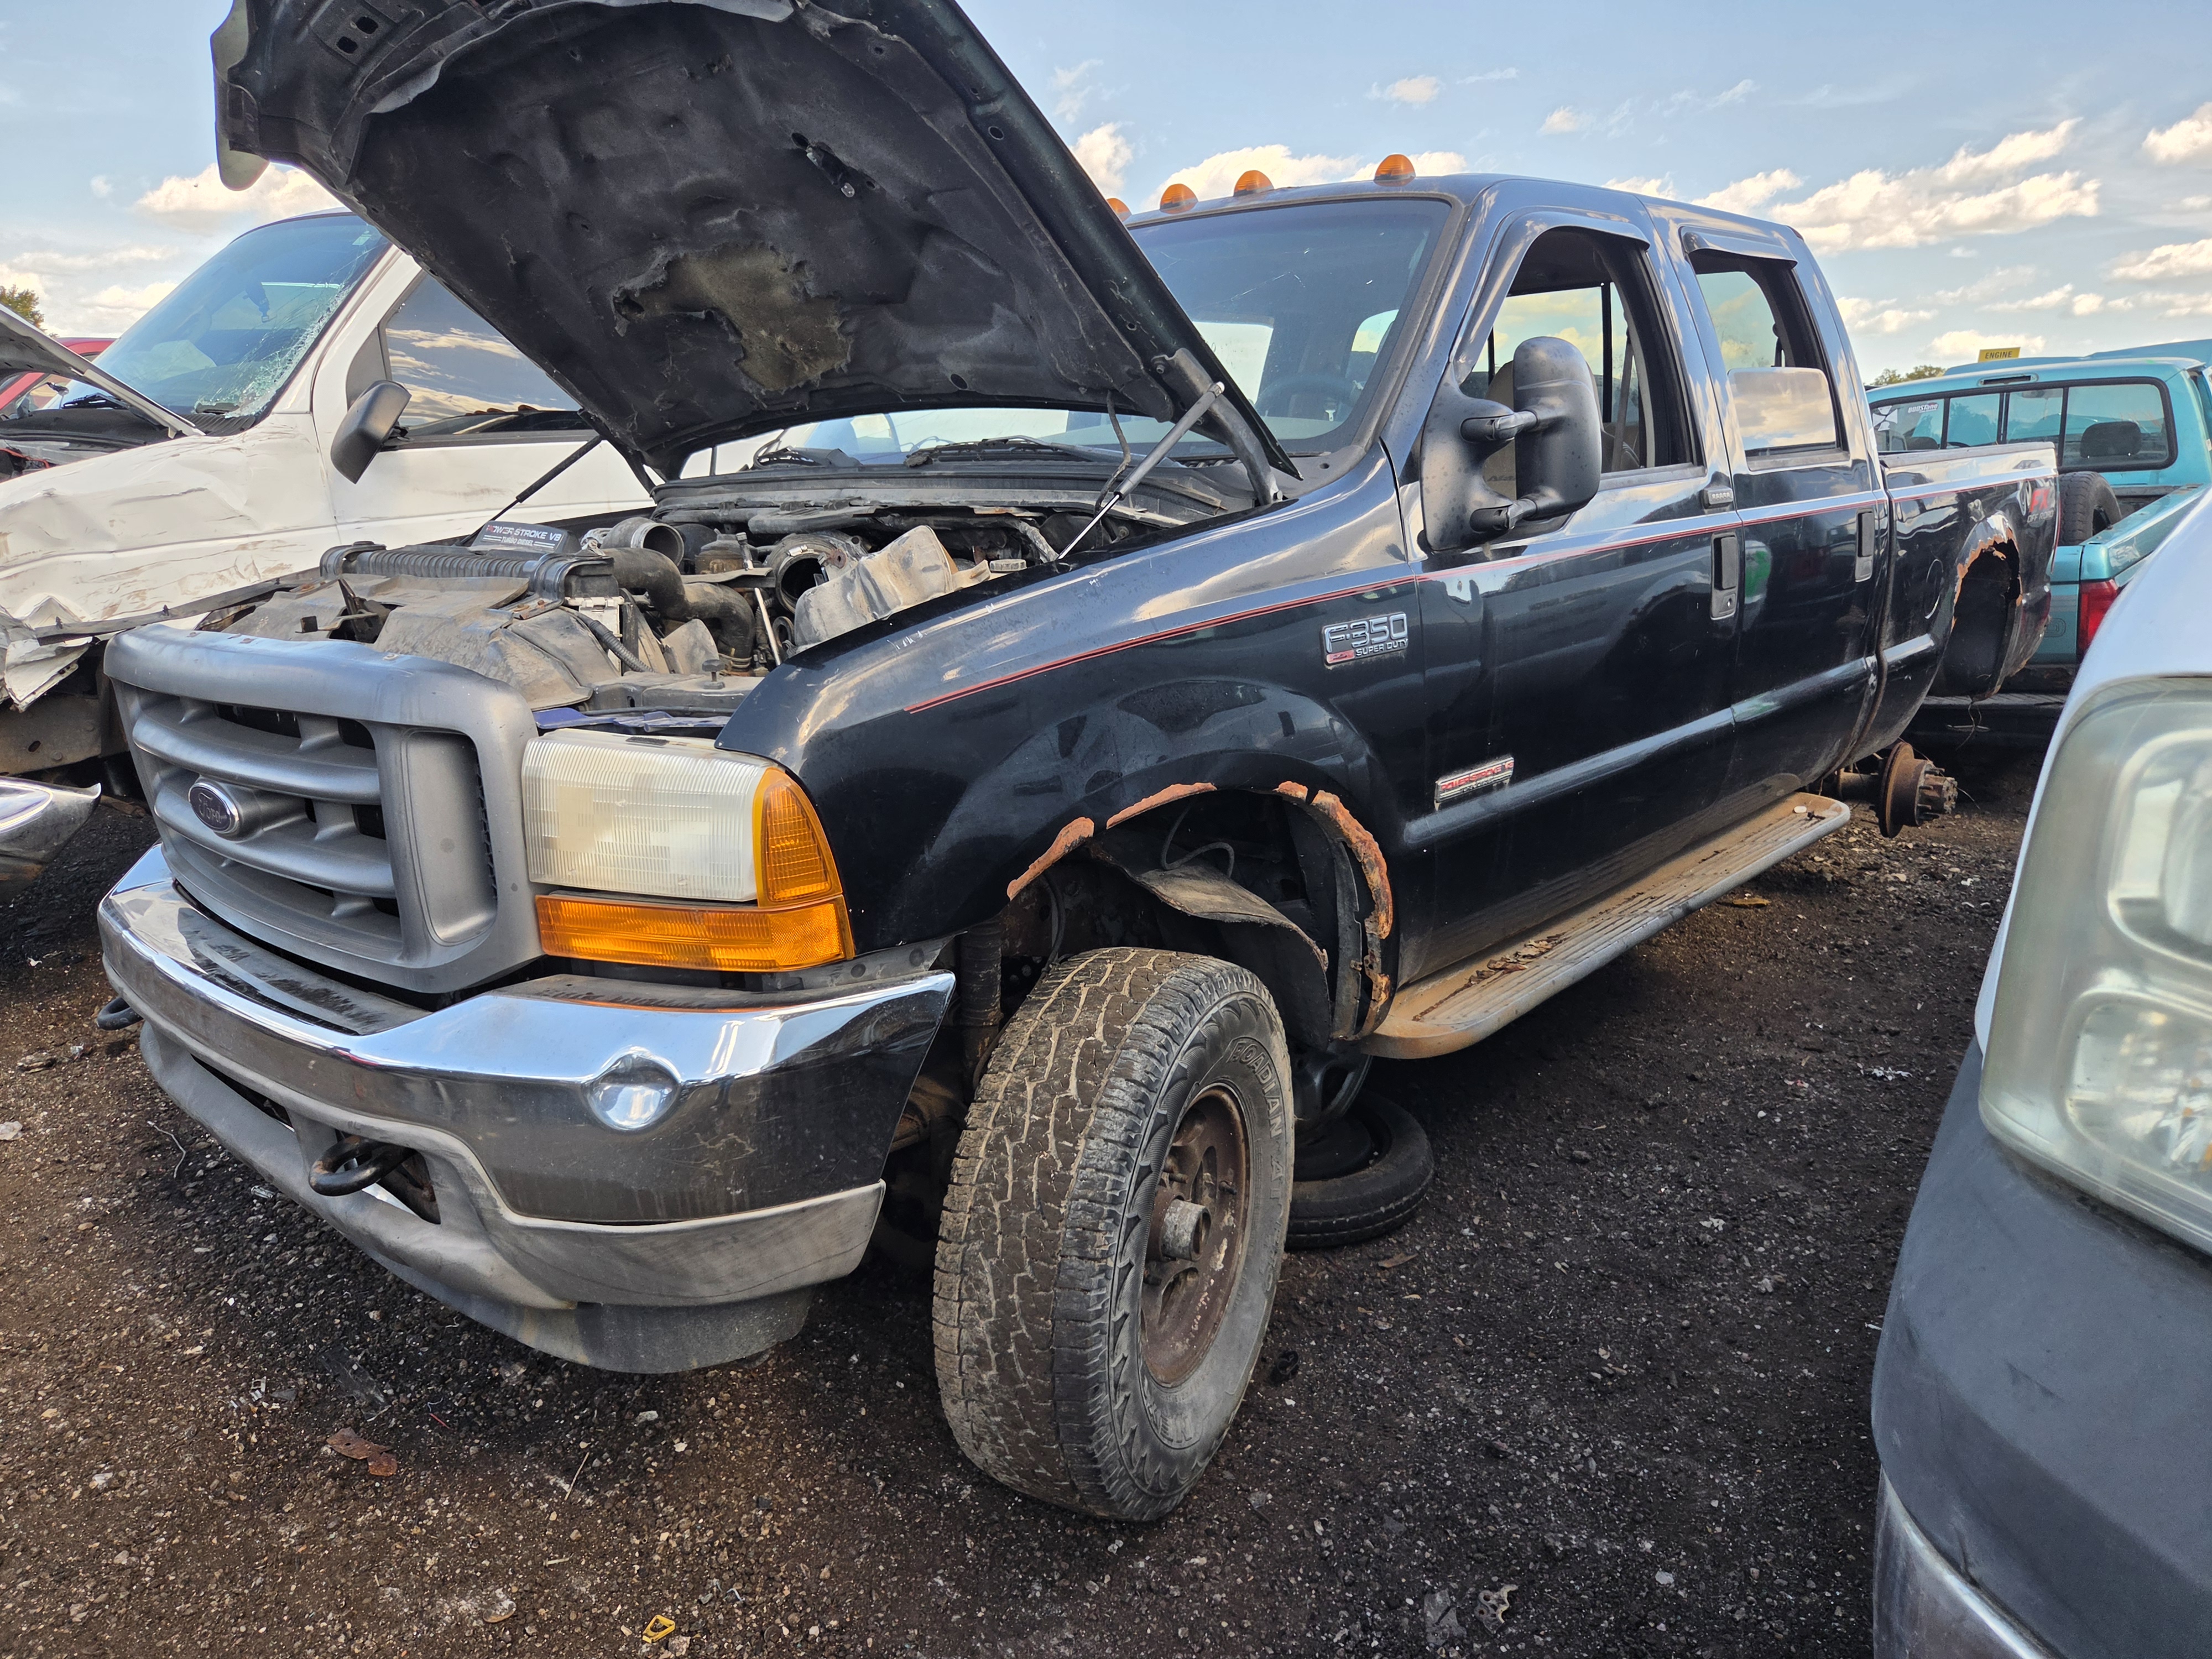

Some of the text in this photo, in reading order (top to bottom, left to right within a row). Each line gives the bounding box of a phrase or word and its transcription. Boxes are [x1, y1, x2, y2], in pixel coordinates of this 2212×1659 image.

[1985, 351, 2013, 359] ENGINE
[2026, 510, 2054, 523] OFF ROAD
[501, 536, 534, 546] TURBO DIESEL
[514, 529, 548, 539] STROKE
[549, 533, 562, 541] V8
[1355, 638, 1408, 656] SUPER DUTY
[198, 792, 222, 824] Ford
[1225, 1041, 1283, 1139] ROADIAN
